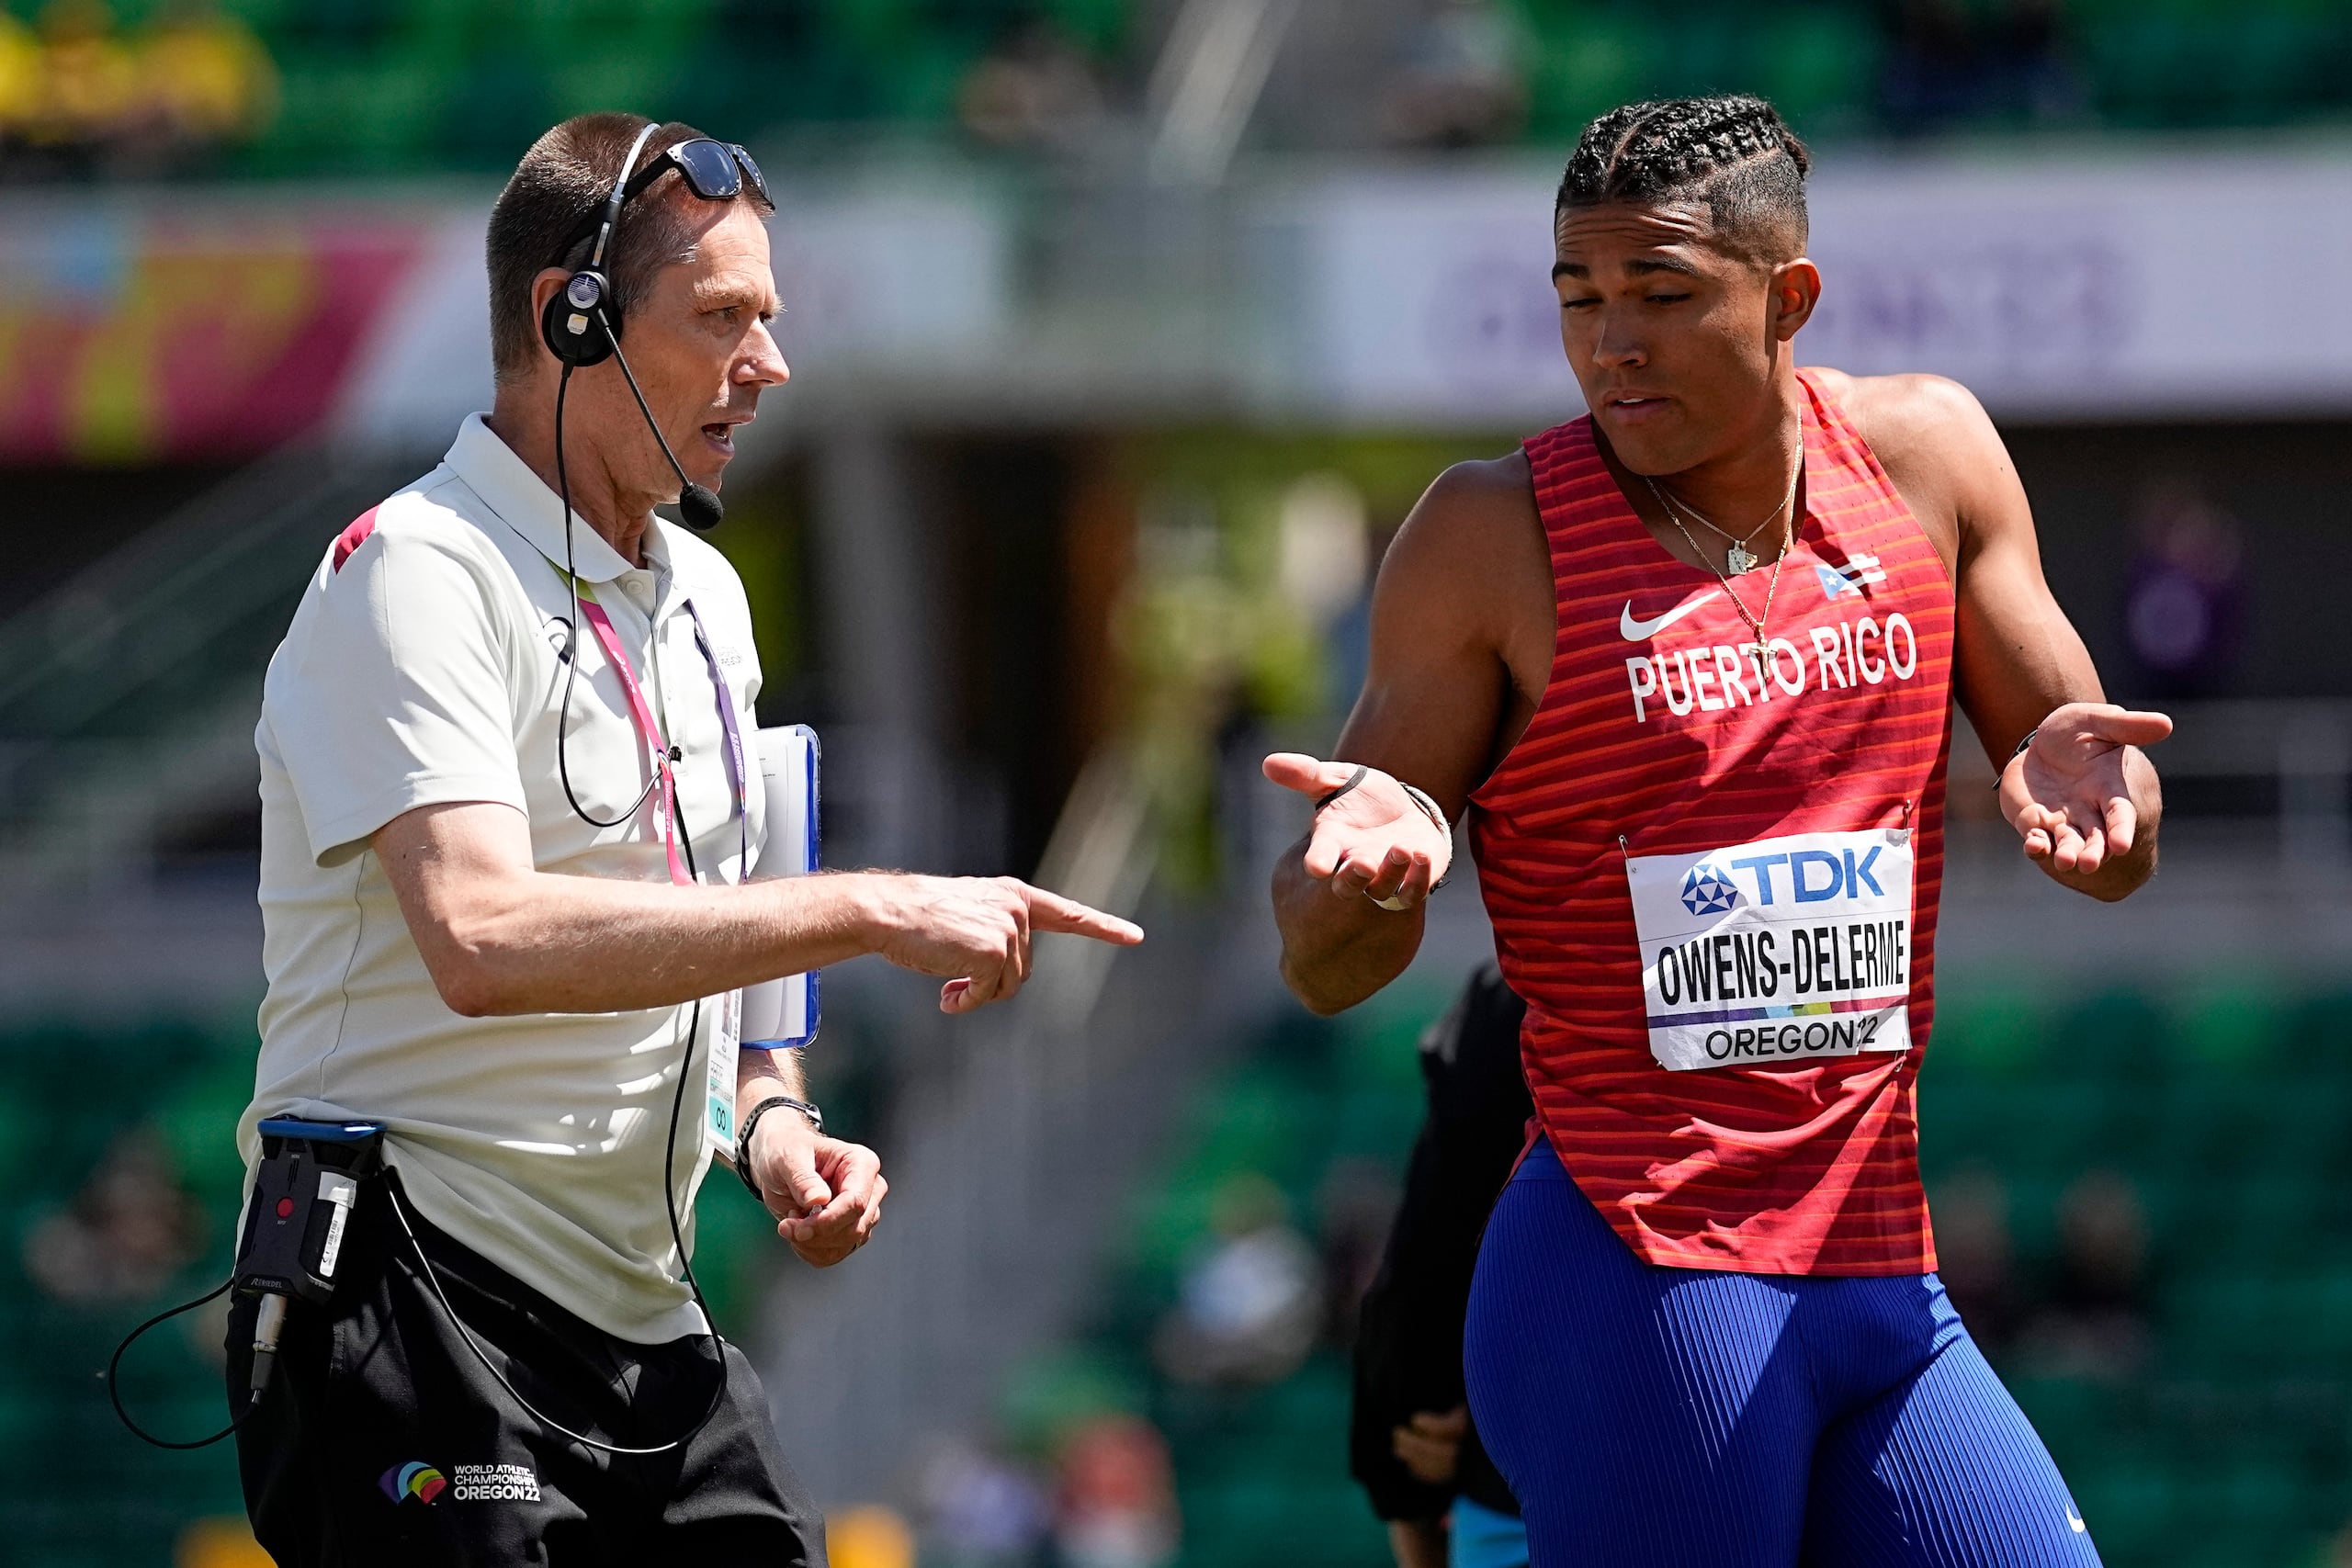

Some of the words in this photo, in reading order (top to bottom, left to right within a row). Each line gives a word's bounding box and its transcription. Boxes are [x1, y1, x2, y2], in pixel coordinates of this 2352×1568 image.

[1625, 637, 1805, 723] PUERTO
[1808, 612, 1917, 691] RICO
[1732, 845, 1885, 906] TDK
[1657, 920, 1905, 1006] OWENS-DELERME
[454, 1464, 494, 1474] WORLD
[454, 1484, 541, 1502] OREGON22
